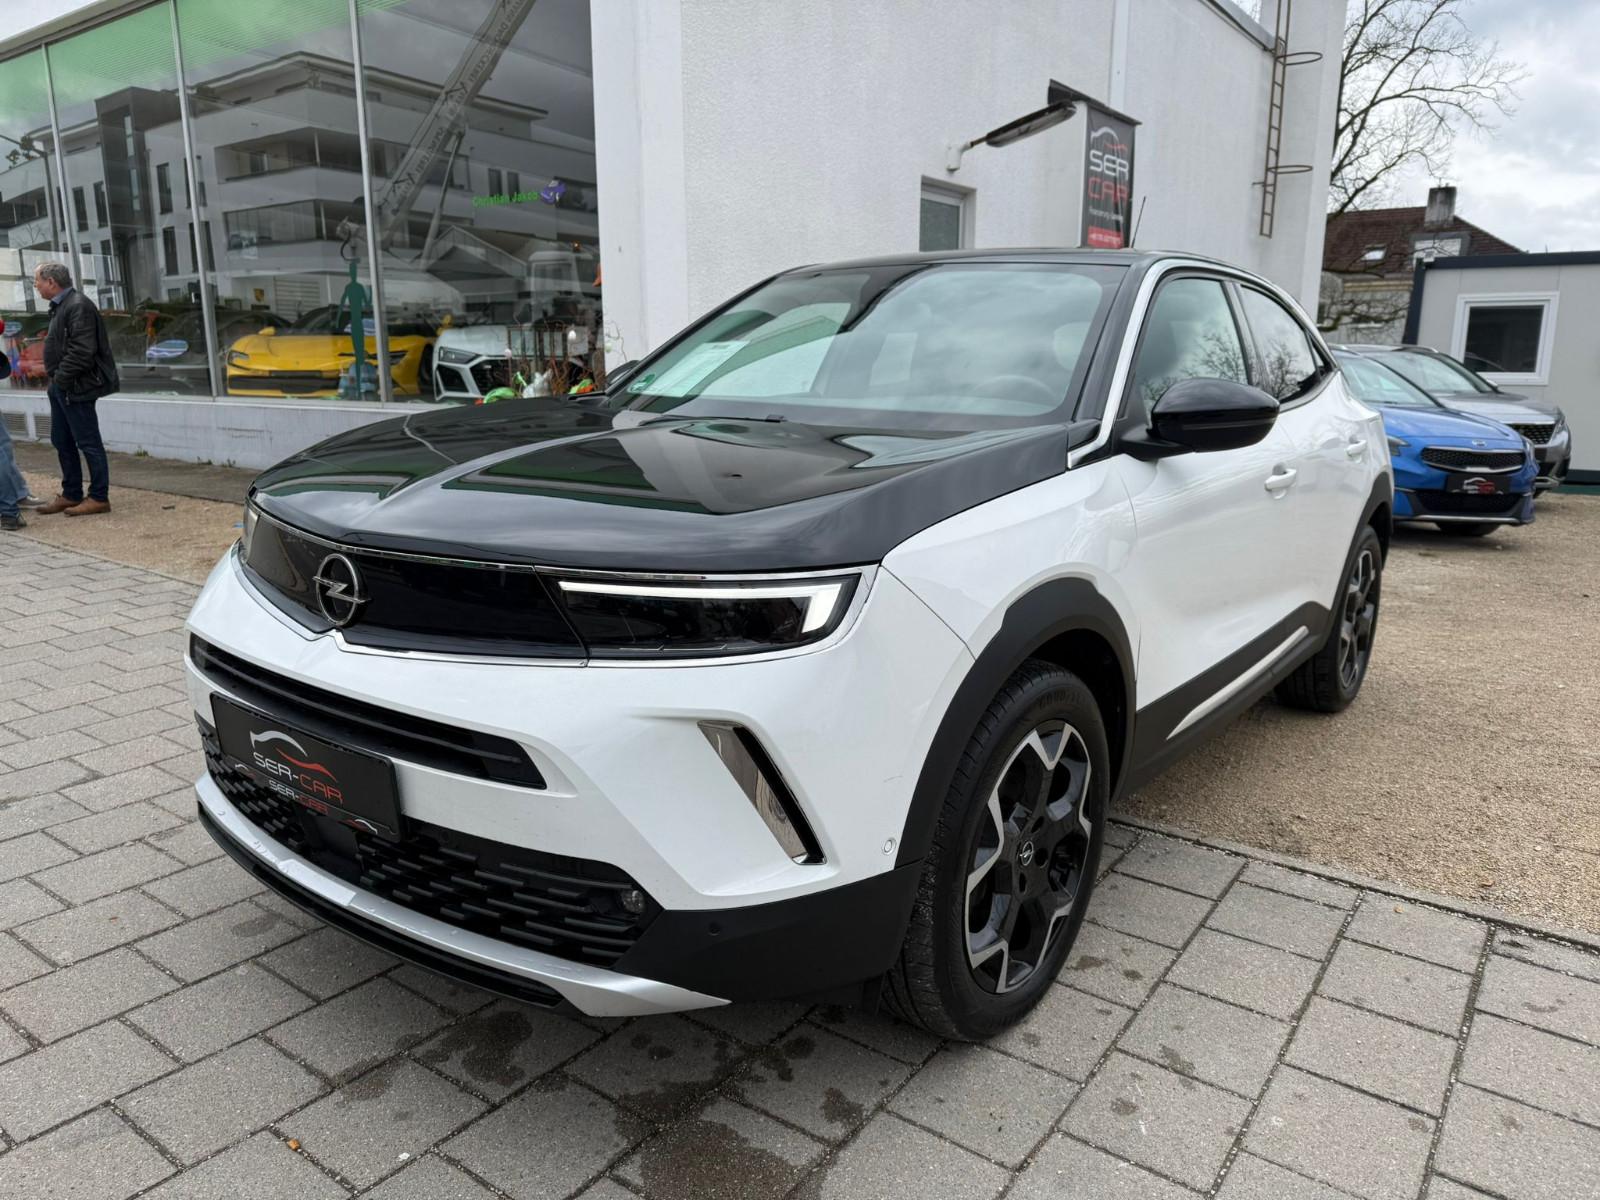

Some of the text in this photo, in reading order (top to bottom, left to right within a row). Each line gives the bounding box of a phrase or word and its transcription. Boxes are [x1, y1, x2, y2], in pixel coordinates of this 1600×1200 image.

[1089, 150, 1129, 181] SER
[1088, 176, 1128, 208] CAR
[253, 752, 344, 804] SER-CAR
